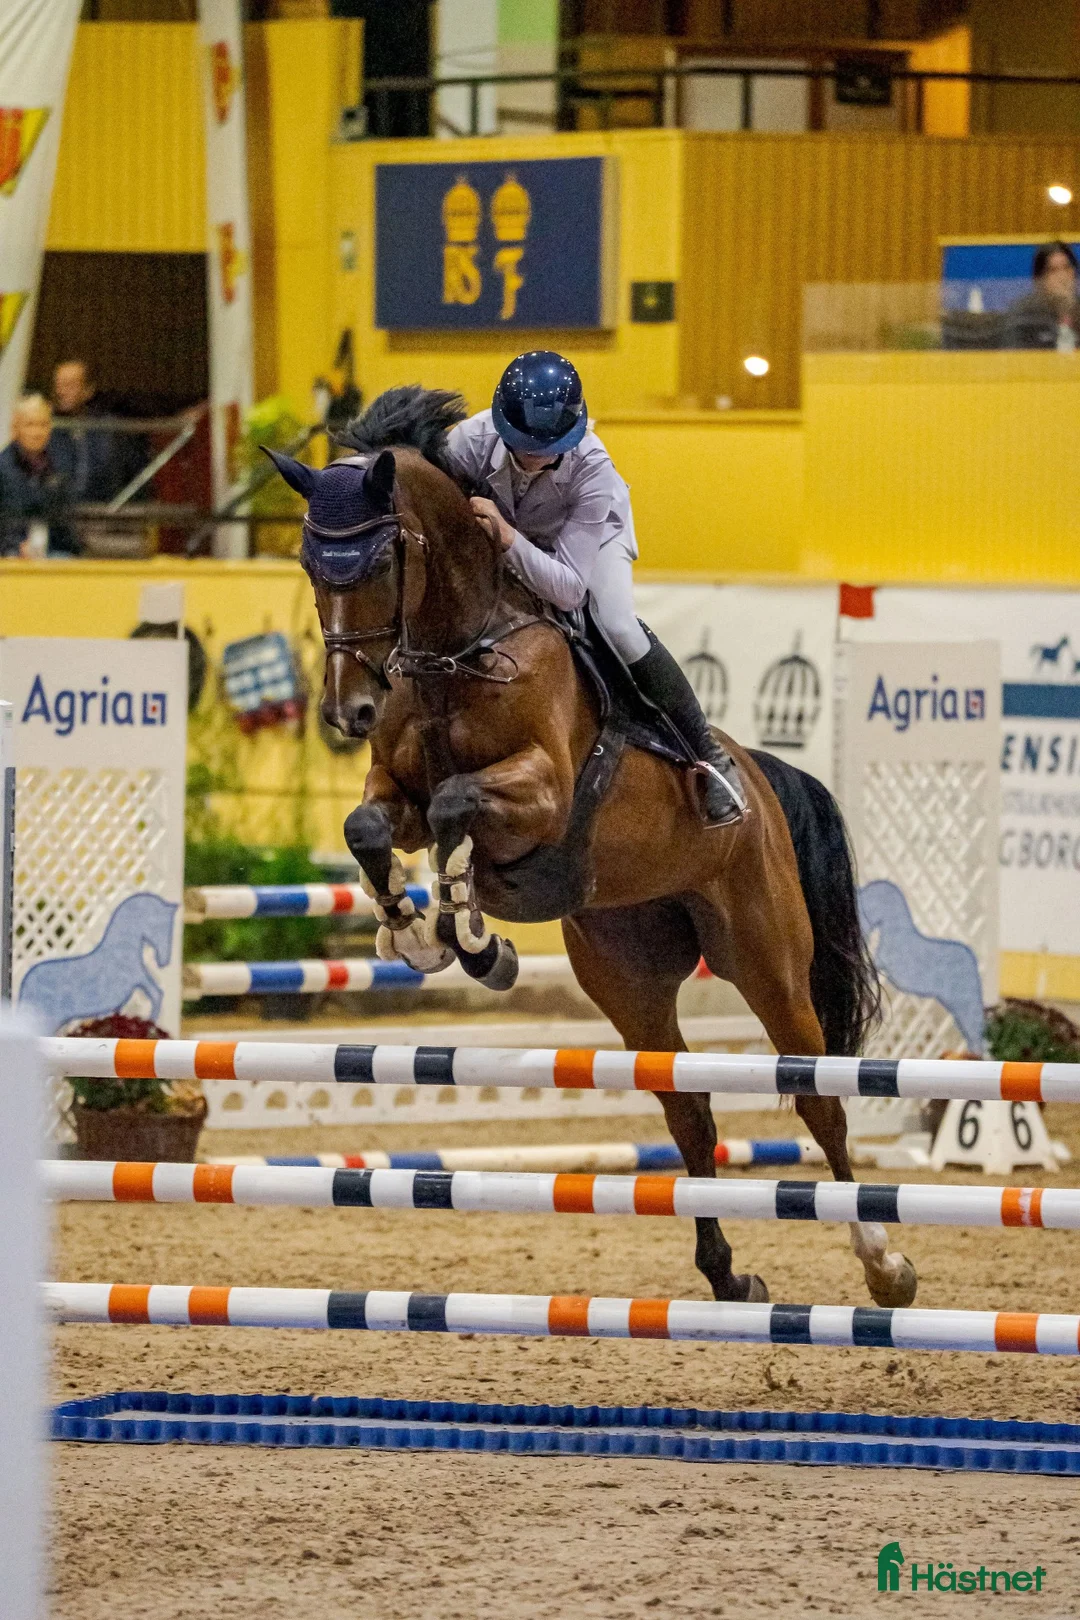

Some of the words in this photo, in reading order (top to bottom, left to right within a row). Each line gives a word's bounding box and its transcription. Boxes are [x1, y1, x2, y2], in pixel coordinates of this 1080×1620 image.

[21, 674, 135, 735] Agria
[867, 674, 959, 732] Agria
[958, 1100, 982, 1150] 6
[1010, 1101, 1032, 1151] 6
